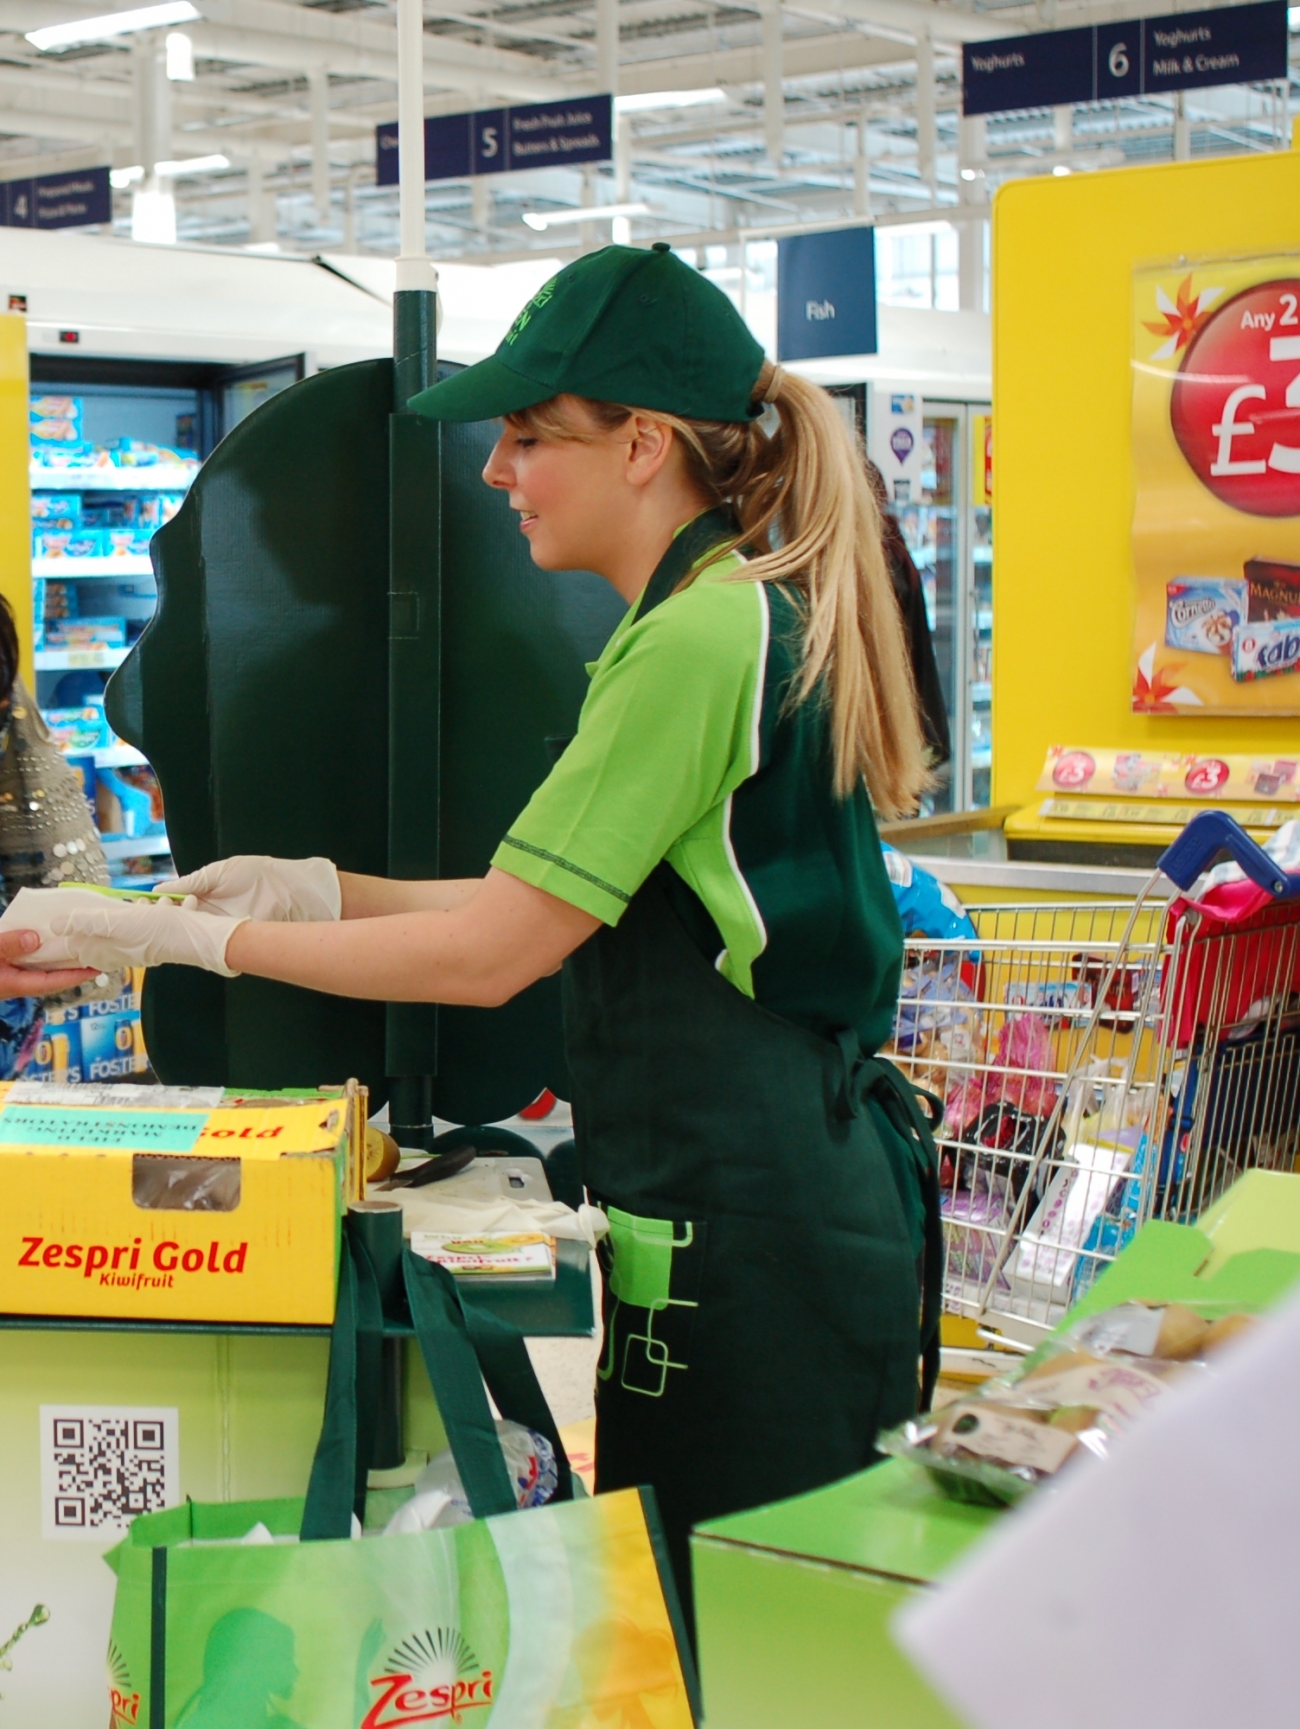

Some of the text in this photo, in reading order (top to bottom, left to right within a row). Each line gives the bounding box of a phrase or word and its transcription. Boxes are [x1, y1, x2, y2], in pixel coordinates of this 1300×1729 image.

[1153, 26, 1212, 49] Yoghurts
[970, 52, 1026, 74] Yoghurts
[1108, 41, 1130, 78] 6
[1152, 53, 1240, 77] Milk & Cream
[481, 126, 499, 158] 5
[13, 195, 28, 220] 4
[805, 299, 836, 321] Fish
[1240, 293, 1299, 331] Any 2
[1249, 581, 1300, 605] MAGNU
[17, 1236, 249, 1278] Zespri Gold
[99, 1272, 175, 1291] Kiwifruit
[360, 1669, 493, 1729] Zespri
